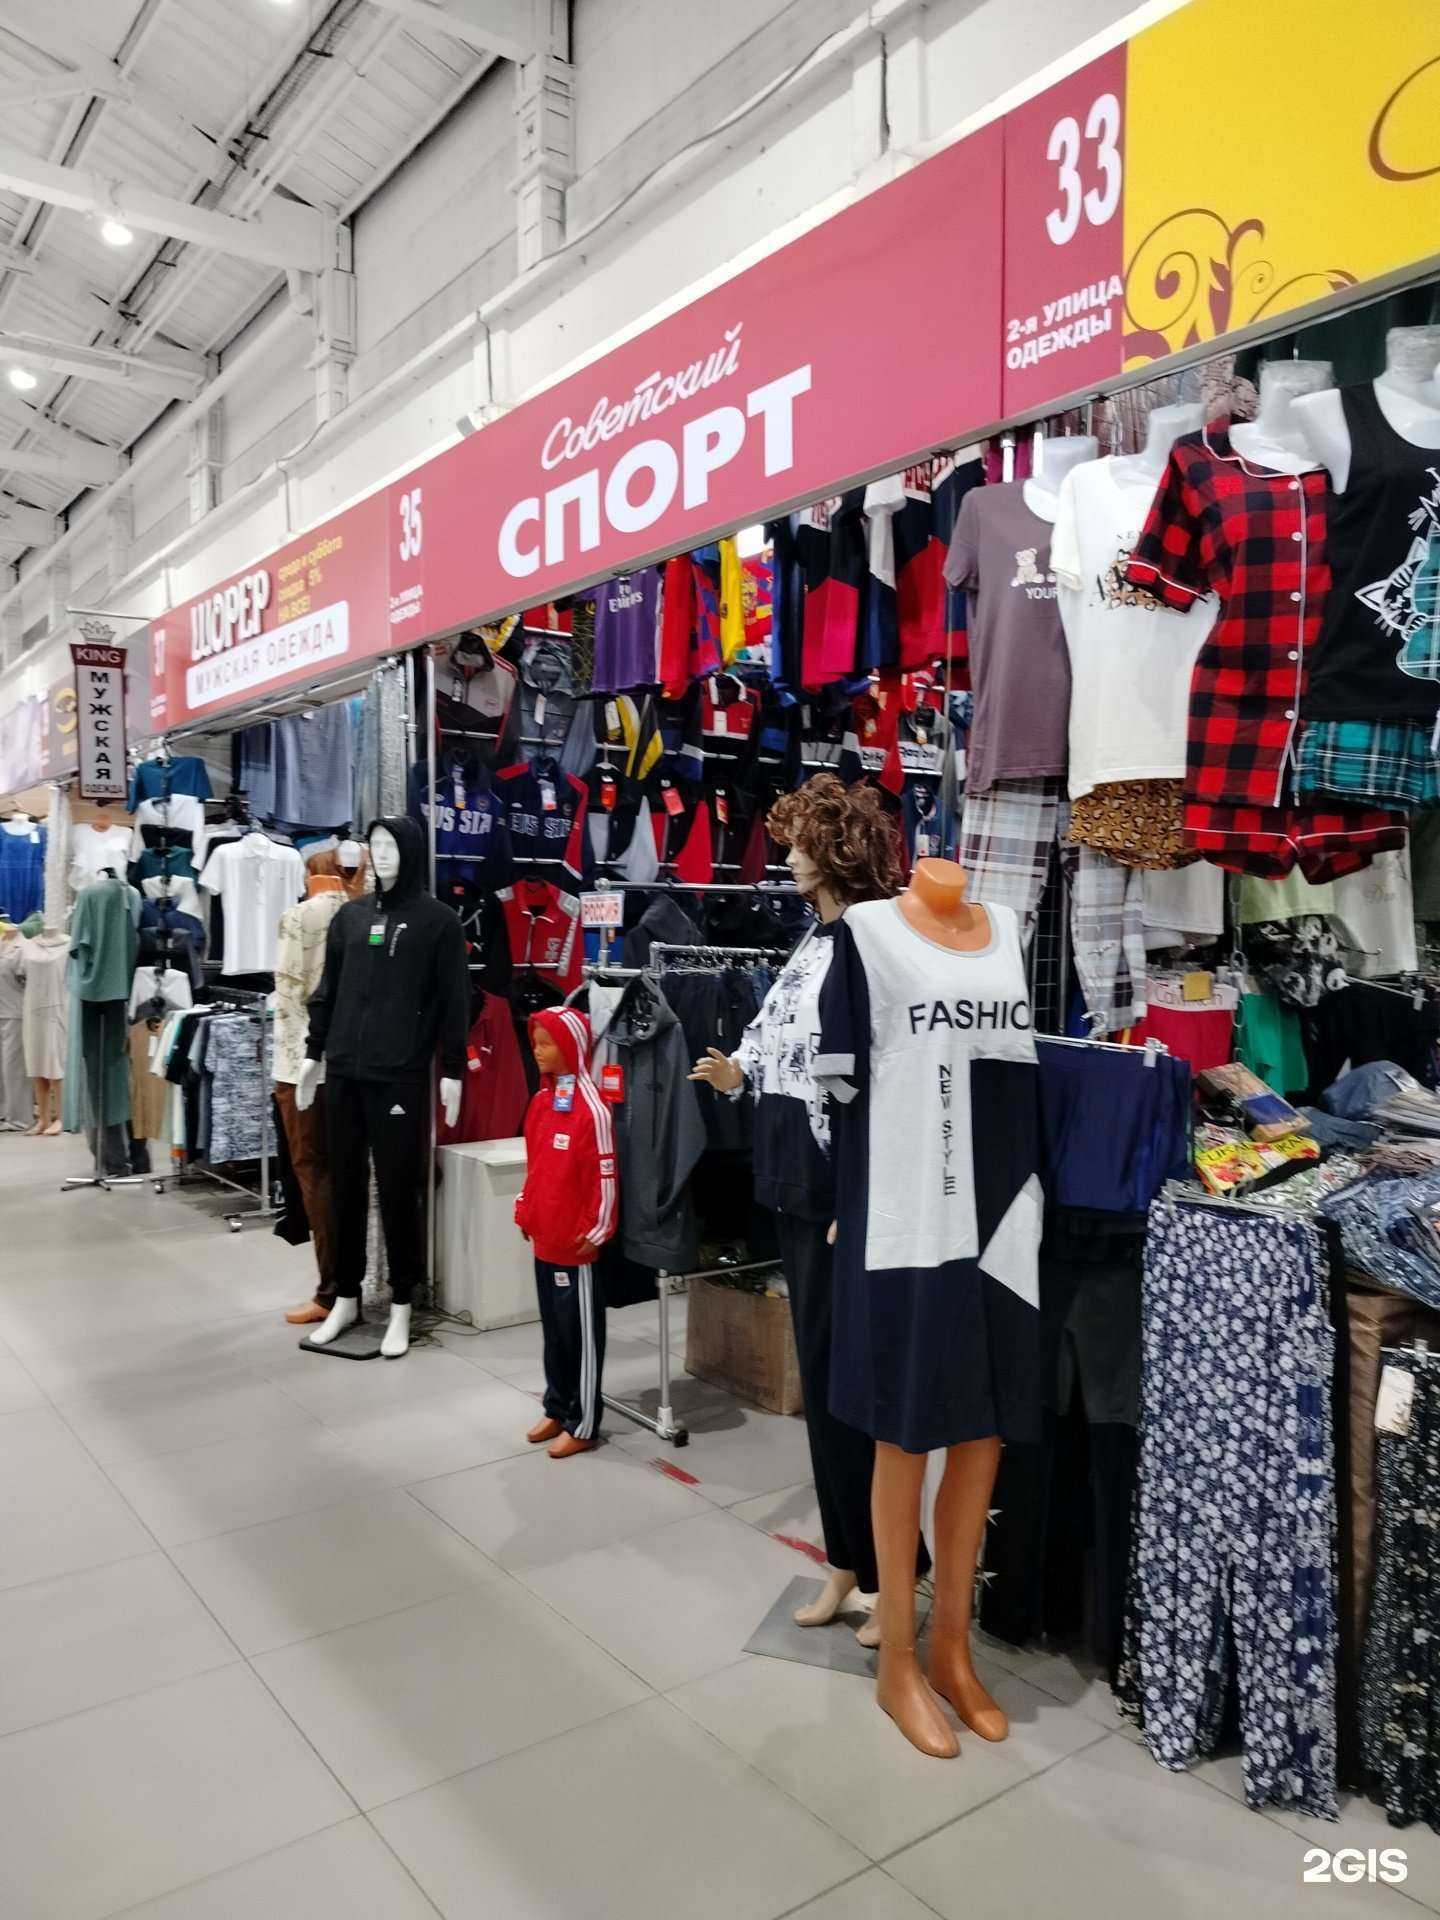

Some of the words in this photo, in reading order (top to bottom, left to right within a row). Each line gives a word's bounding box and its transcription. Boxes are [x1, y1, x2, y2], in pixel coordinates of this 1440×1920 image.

[1046, 93, 1122, 246] 33
[1006, 316, 1038, 343] 2-я
[1042, 275, 1124, 327] УЛИЦА
[1006, 308, 1112, 369] ОДЕЖДЫ
[541, 321, 743, 470] Советский
[497, 363, 812, 578] СПОРТ
[400, 488, 422, 562] 35
[76, 648, 121, 664] KING
[267, 618, 336, 667] ОДЕЖДА
[89, 671, 113, 780] МУЖСКАЯ
[938, 1064, 953, 1110] NEW
[942, 1120, 957, 1196] STYLE
